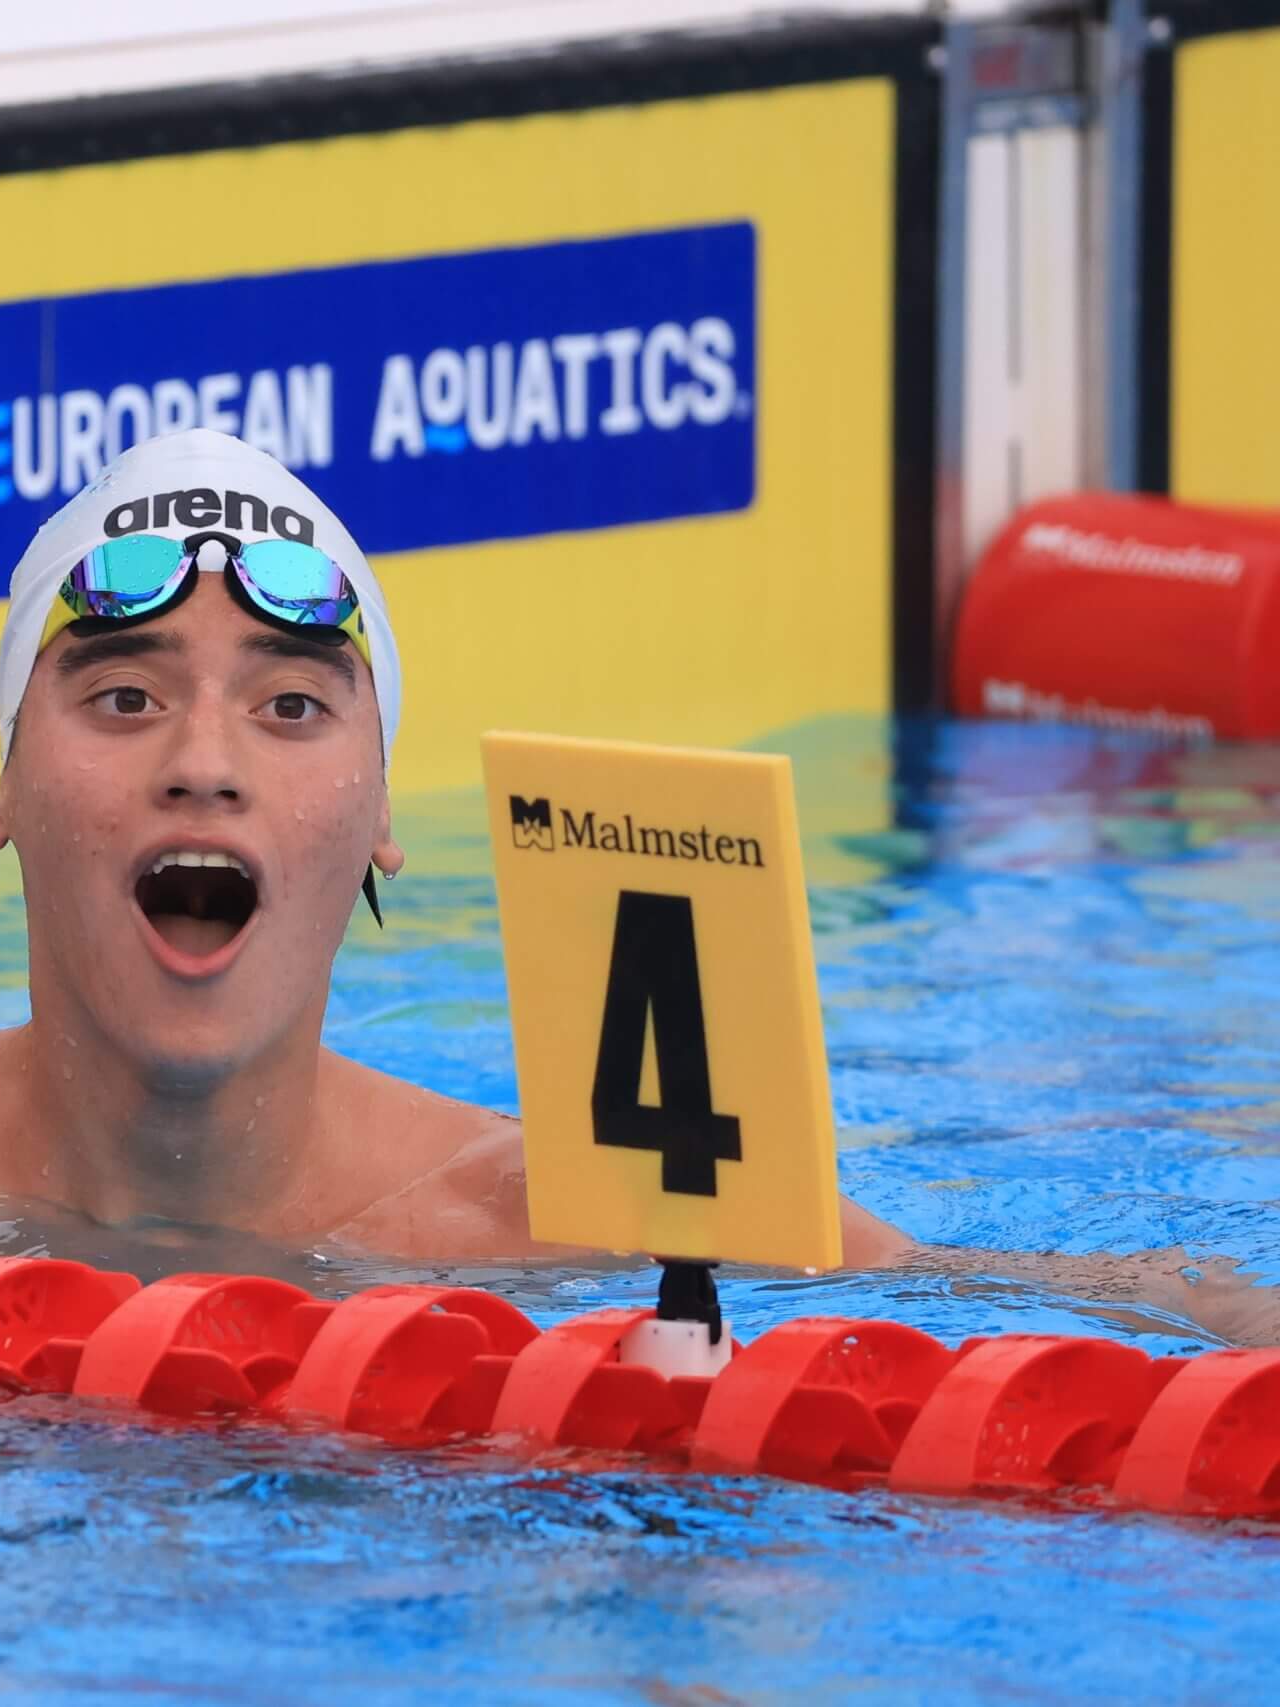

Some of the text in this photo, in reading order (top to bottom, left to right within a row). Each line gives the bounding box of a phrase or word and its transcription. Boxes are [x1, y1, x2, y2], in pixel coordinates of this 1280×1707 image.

[369, 316, 737, 460] AQUATICS
[103, 488, 314, 546] arena
[559, 808, 766, 868] Malmsten
[591, 889, 742, 1197] 4
